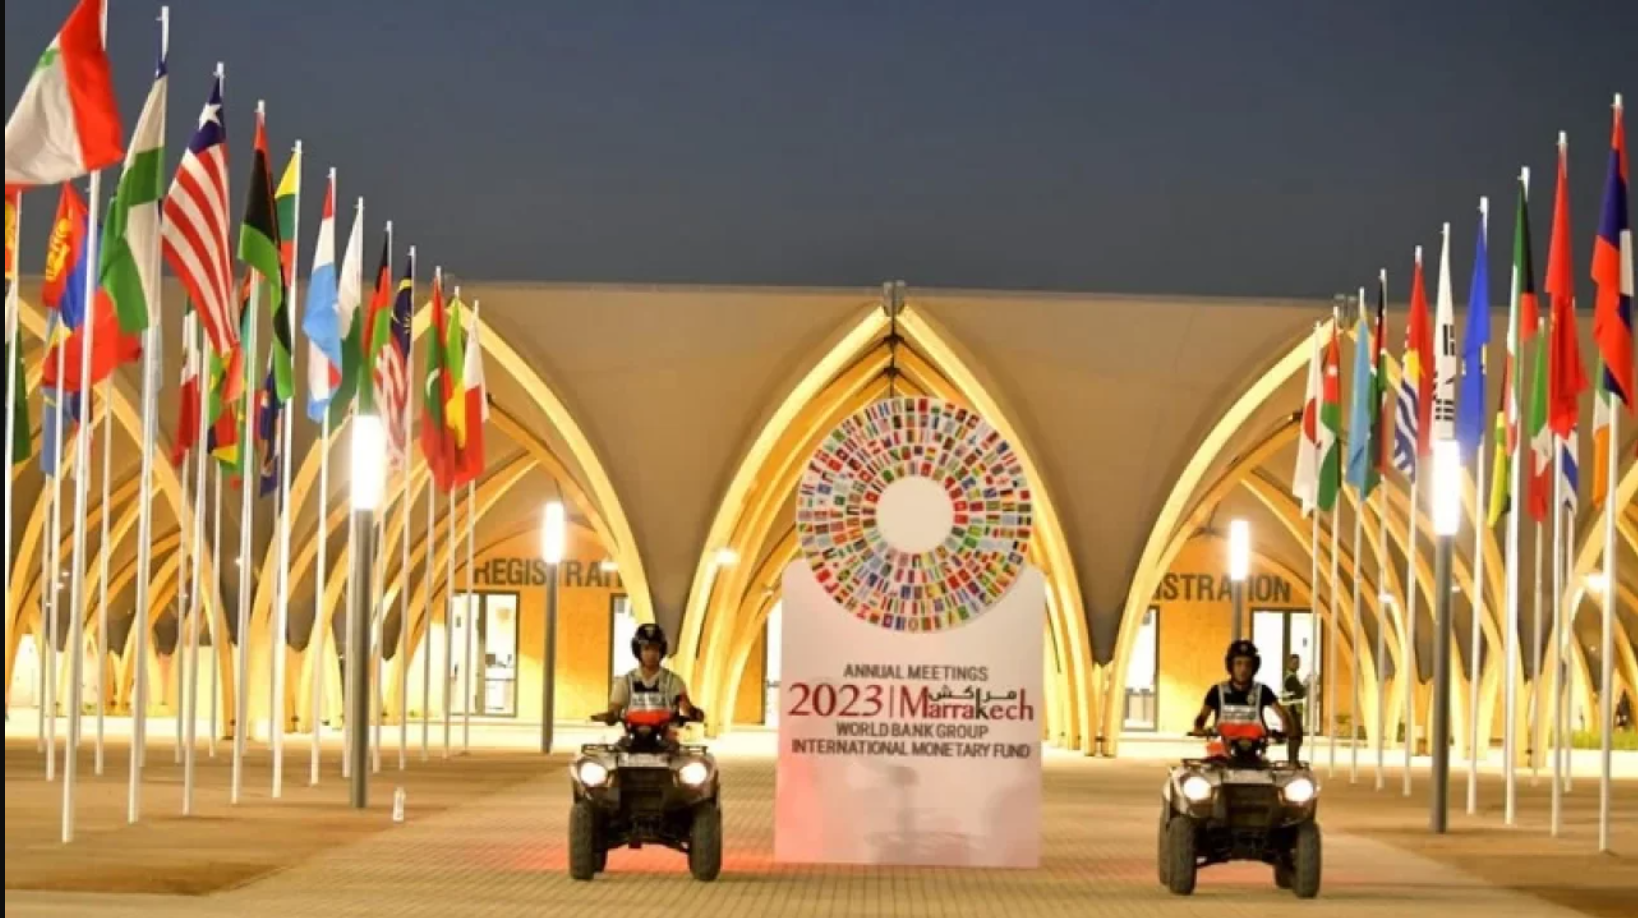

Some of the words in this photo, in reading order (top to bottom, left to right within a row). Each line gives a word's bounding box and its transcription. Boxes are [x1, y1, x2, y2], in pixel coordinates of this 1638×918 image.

[844, 664, 904, 679] ANNUAL
[907, 665, 989, 681] MEETINGS
[788, 682, 883, 717] 2023
[900, 685, 1034, 721] Marrakech
[836, 722, 889, 737] WORLD
[891, 722, 934, 738] BANK
[936, 724, 989, 739] GROUP
[791, 739, 908, 757] INTERNATIONAL
[911, 741, 991, 757] MONETARY
[992, 743, 1031, 758] FUND
